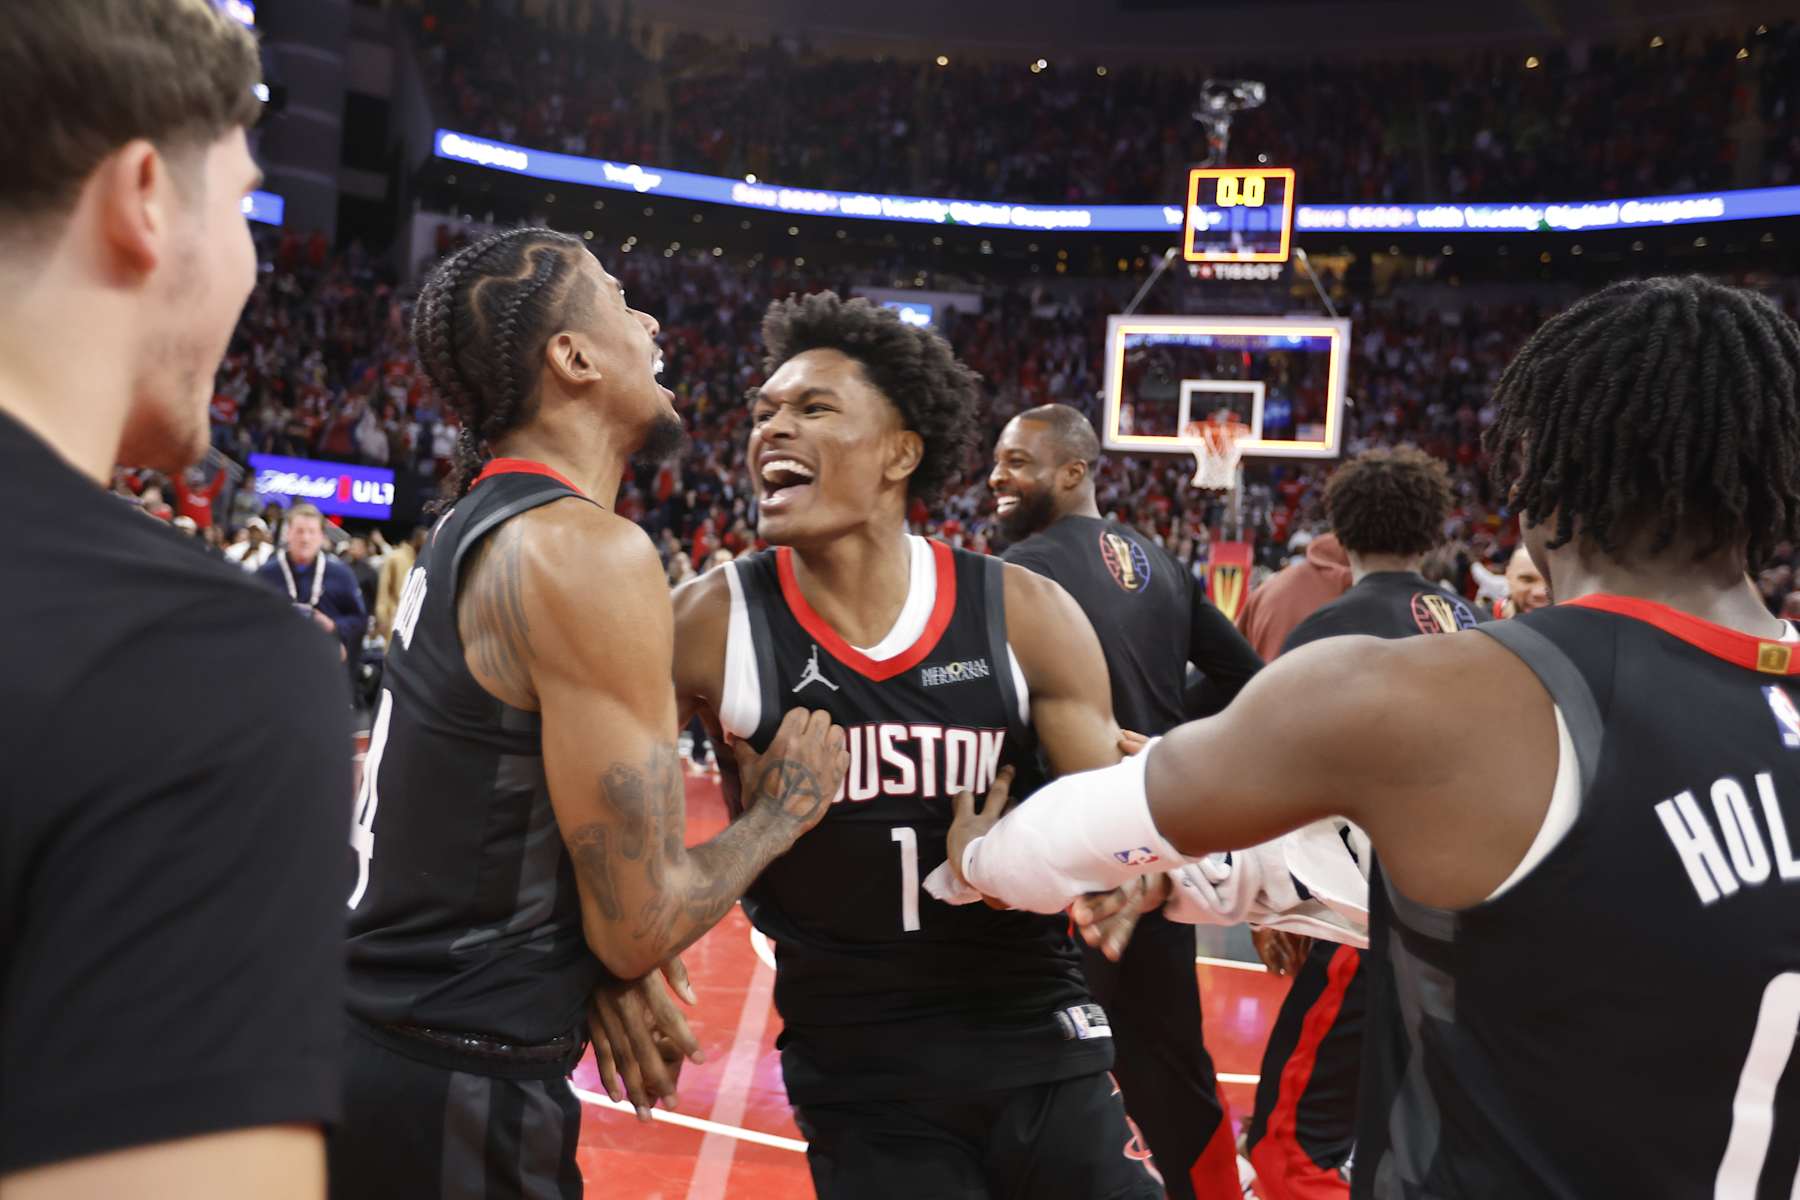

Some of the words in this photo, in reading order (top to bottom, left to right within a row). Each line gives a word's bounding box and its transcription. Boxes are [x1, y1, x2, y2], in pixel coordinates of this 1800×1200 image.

[1216, 176, 1265, 207] 0.0
[1416, 206, 1464, 228] with
[921, 659, 988, 678] MEMORIAL
[922, 665, 990, 687] HERMANN
[832, 722, 1006, 803] USTON
[891, 827, 921, 931] 1
